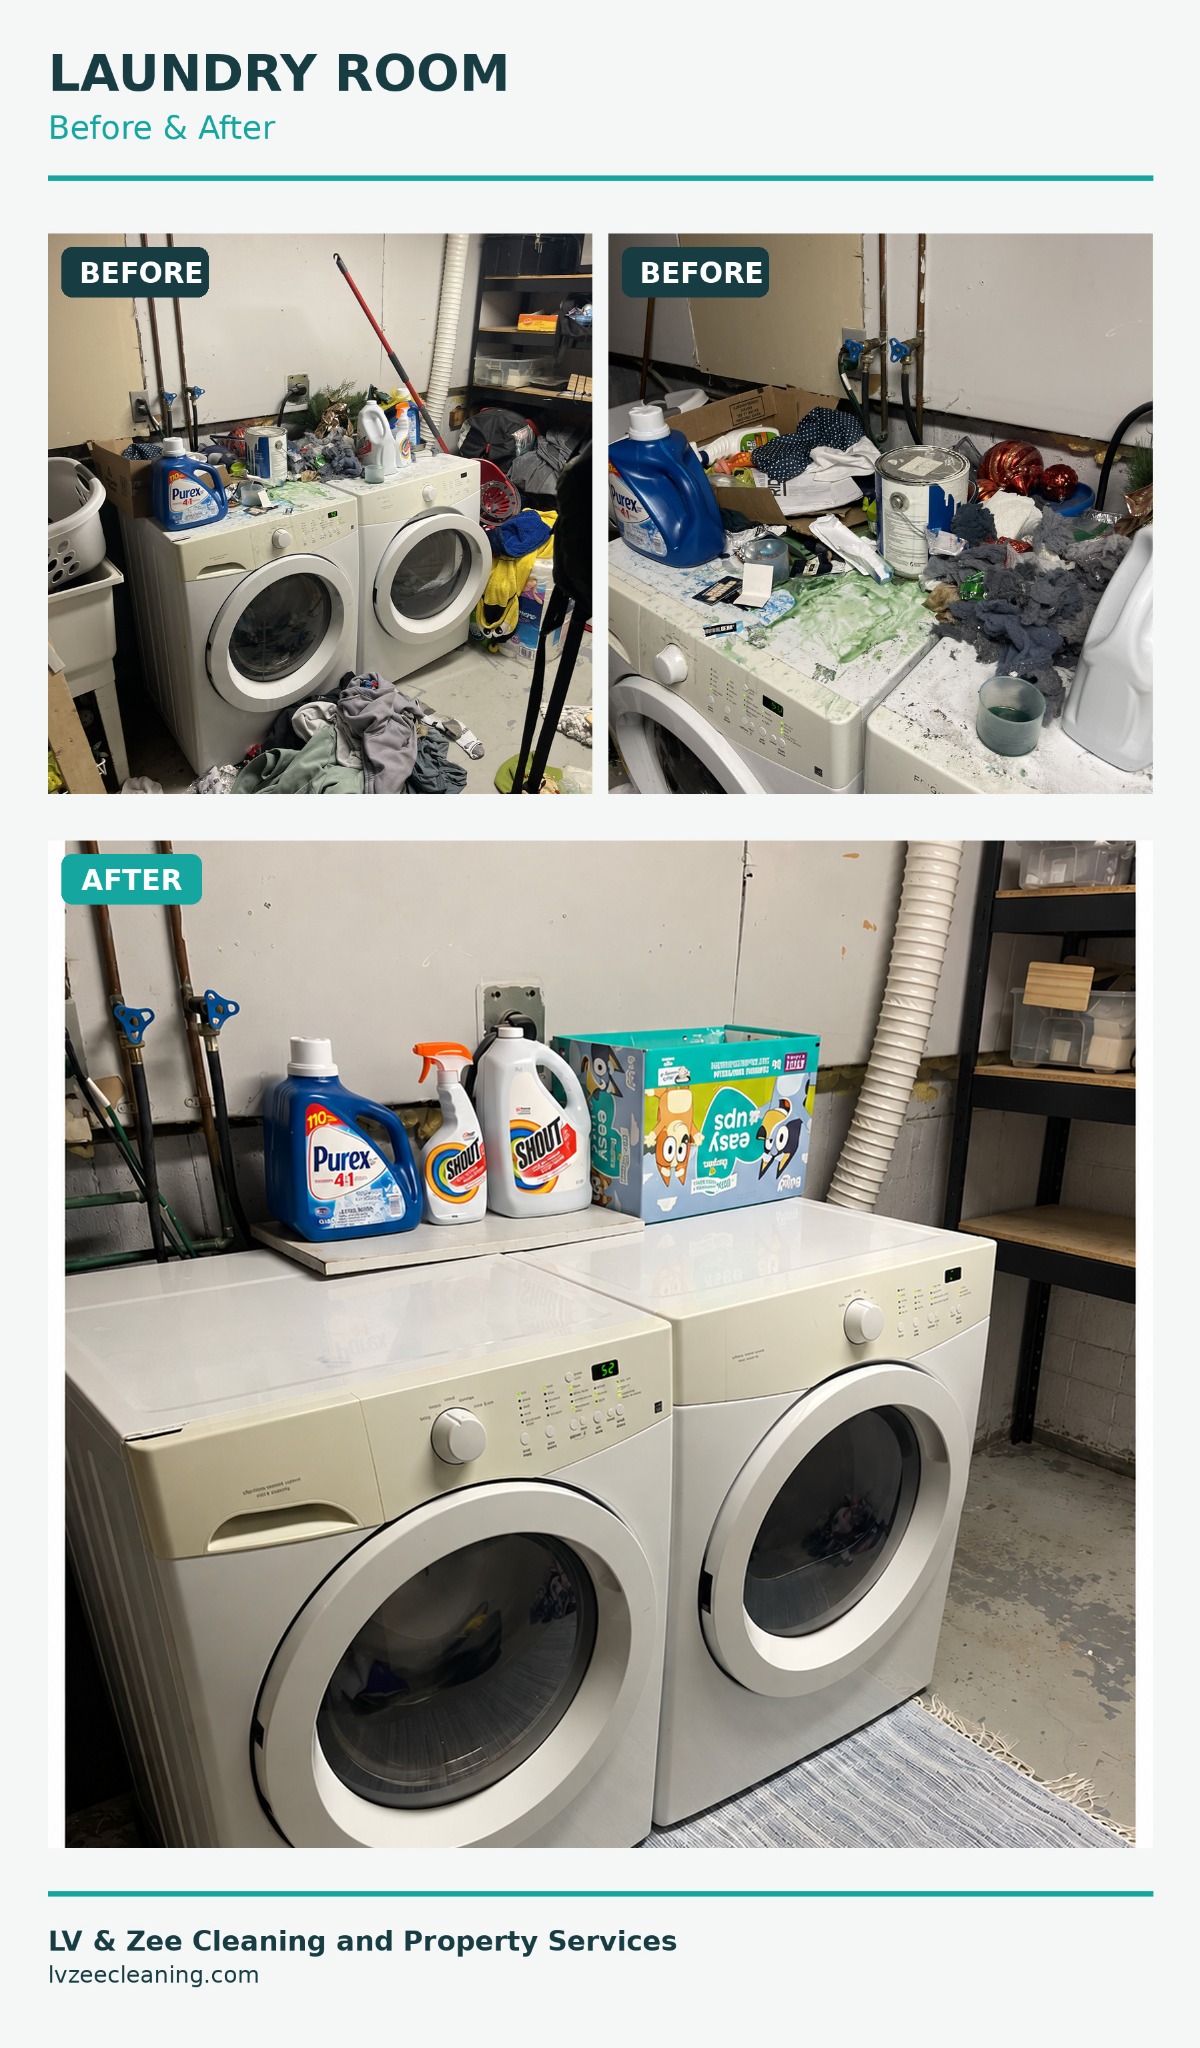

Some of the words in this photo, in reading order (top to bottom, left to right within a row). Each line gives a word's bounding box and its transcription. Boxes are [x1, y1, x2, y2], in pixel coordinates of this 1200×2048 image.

[172, 487, 201, 500] Purex
[307, 1110, 327, 1129] 110
[714, 1108, 748, 1131] ups
[515, 1116, 562, 1169] SHOUT
[708, 1131, 751, 1153] easy
[314, 1146, 370, 1172] Purex
[446, 1138, 480, 1180] SHOUT
[601, 1362, 615, 1376] 52
